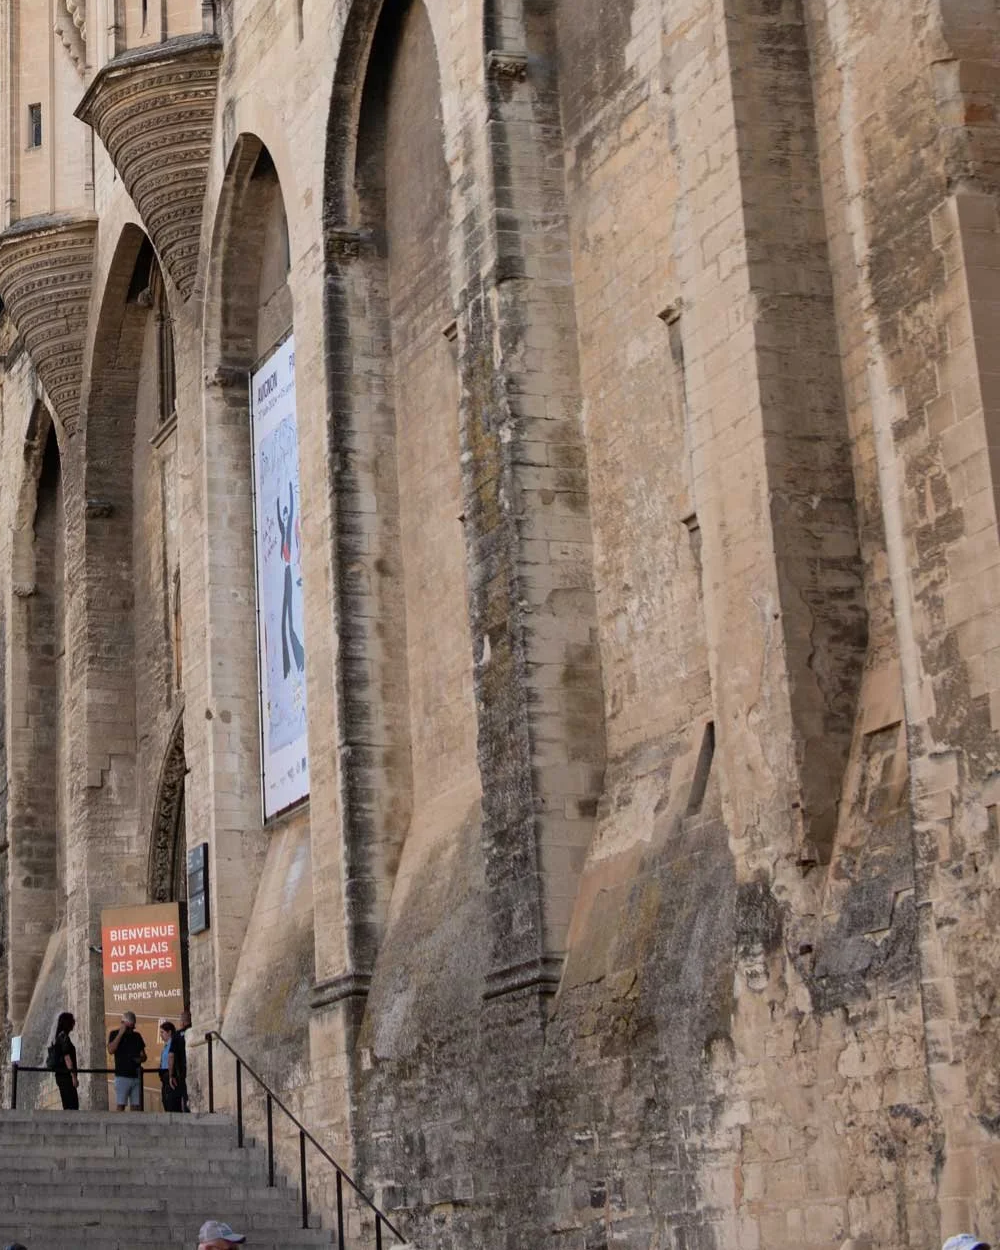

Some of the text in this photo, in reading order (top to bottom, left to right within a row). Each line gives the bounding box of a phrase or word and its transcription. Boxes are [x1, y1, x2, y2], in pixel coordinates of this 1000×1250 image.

[110, 925, 174, 941] BIENVENUE
[111, 942, 168, 957] AU PALAIS
[112, 958, 172, 972] DES PAPES
[113, 981, 158, 991] WELCOME TO
[113, 988, 181, 1001] THE POPES' PALACE
